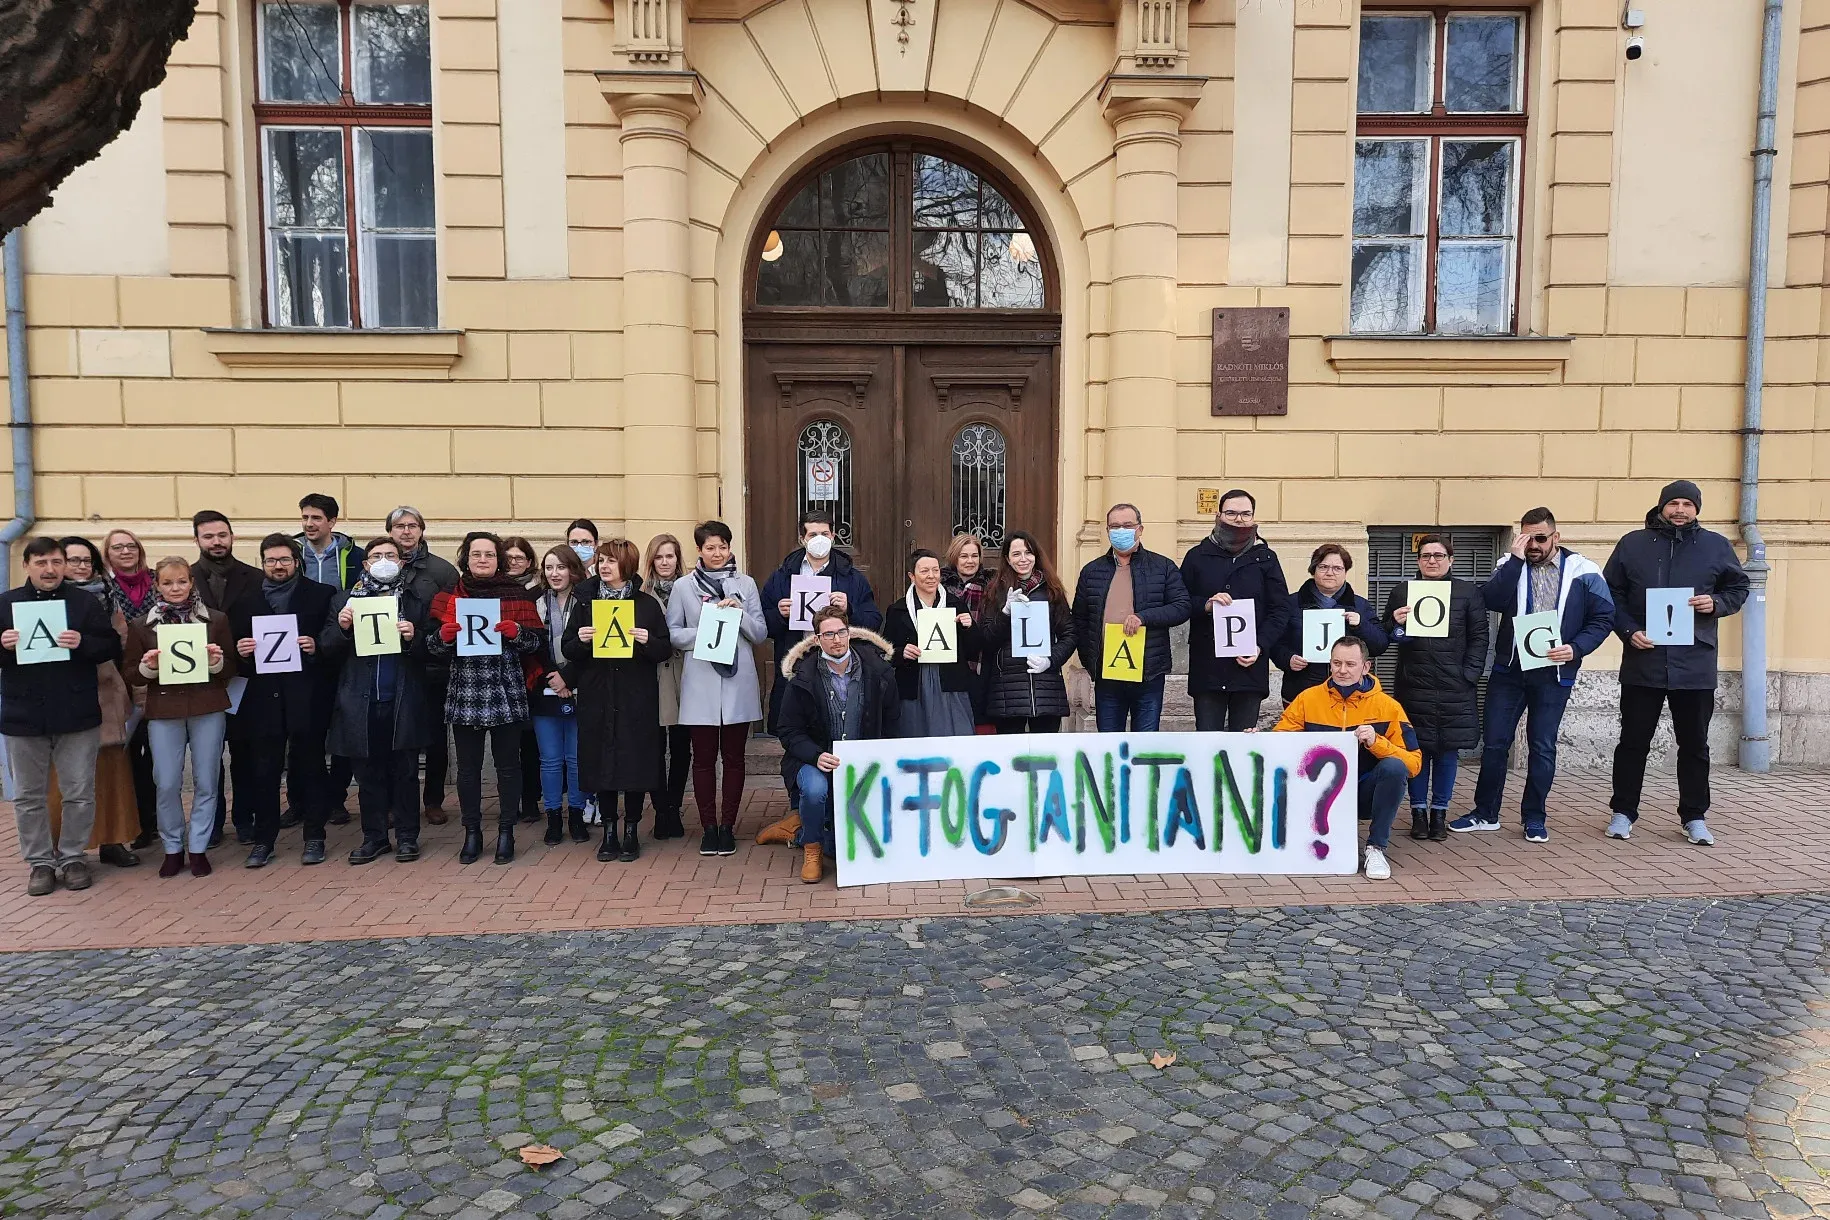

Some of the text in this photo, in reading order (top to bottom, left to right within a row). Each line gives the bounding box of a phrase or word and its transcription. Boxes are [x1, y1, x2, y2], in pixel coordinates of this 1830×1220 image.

[797, 591, 824, 622] K
[1413, 595, 1446, 628] O
[1666, 604, 1674, 637] !
[25, 617, 59, 651] A
[360, 612, 389, 646] T
[464, 614, 496, 646] R
[600, 606, 630, 649] Á
[707, 620, 728, 650] J
[924, 622, 953, 651] A
[1019, 617, 1044, 648] L
[1222, 615, 1247, 648] P
[1315, 622, 1333, 651] J
[1523, 625, 1559, 659] G
[170, 640, 196, 674] S
[263, 631, 292, 663] Z
[1108, 639, 1138, 670] A
